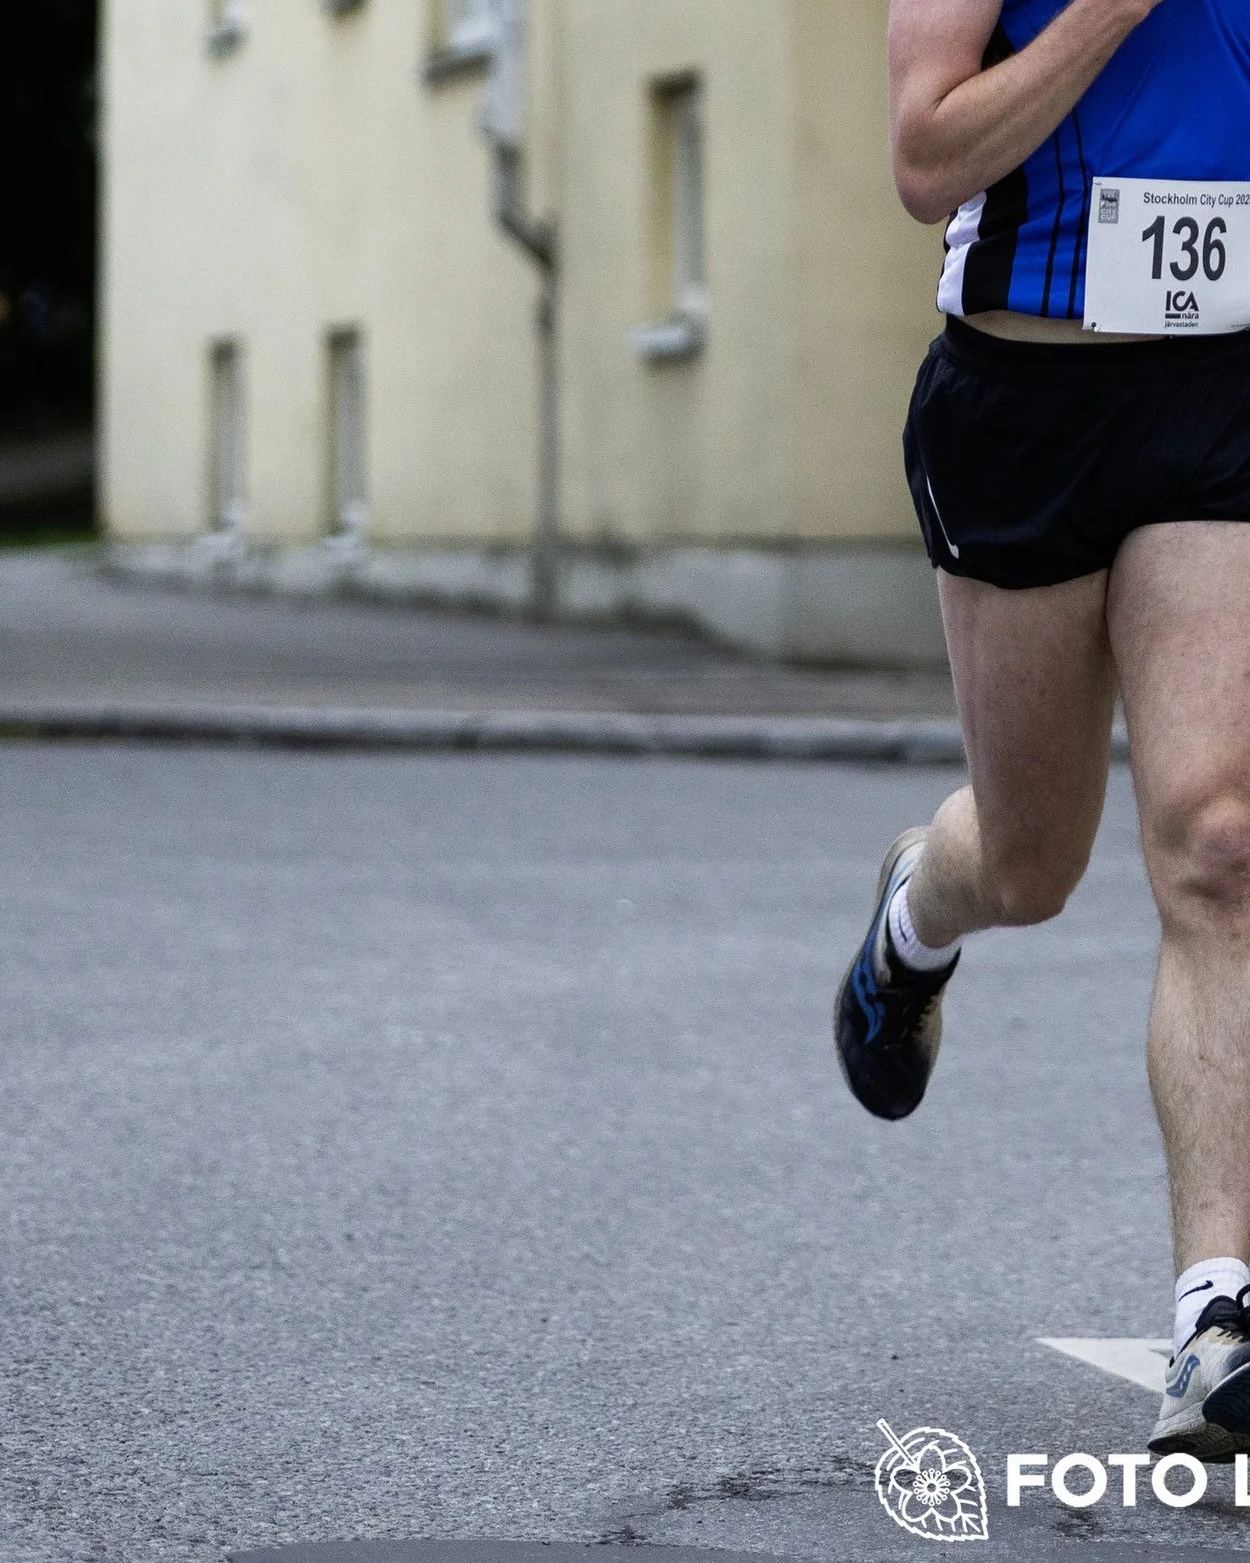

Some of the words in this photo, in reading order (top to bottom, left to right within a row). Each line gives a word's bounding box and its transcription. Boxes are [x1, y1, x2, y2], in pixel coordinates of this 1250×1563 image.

[1143, 192, 1198, 206] Stockholm
[1199, 193, 1215, 208] City
[1218, 193, 1234, 208] Cup
[1141, 215, 1227, 282] 136
[1165, 290, 1200, 312] ICA
